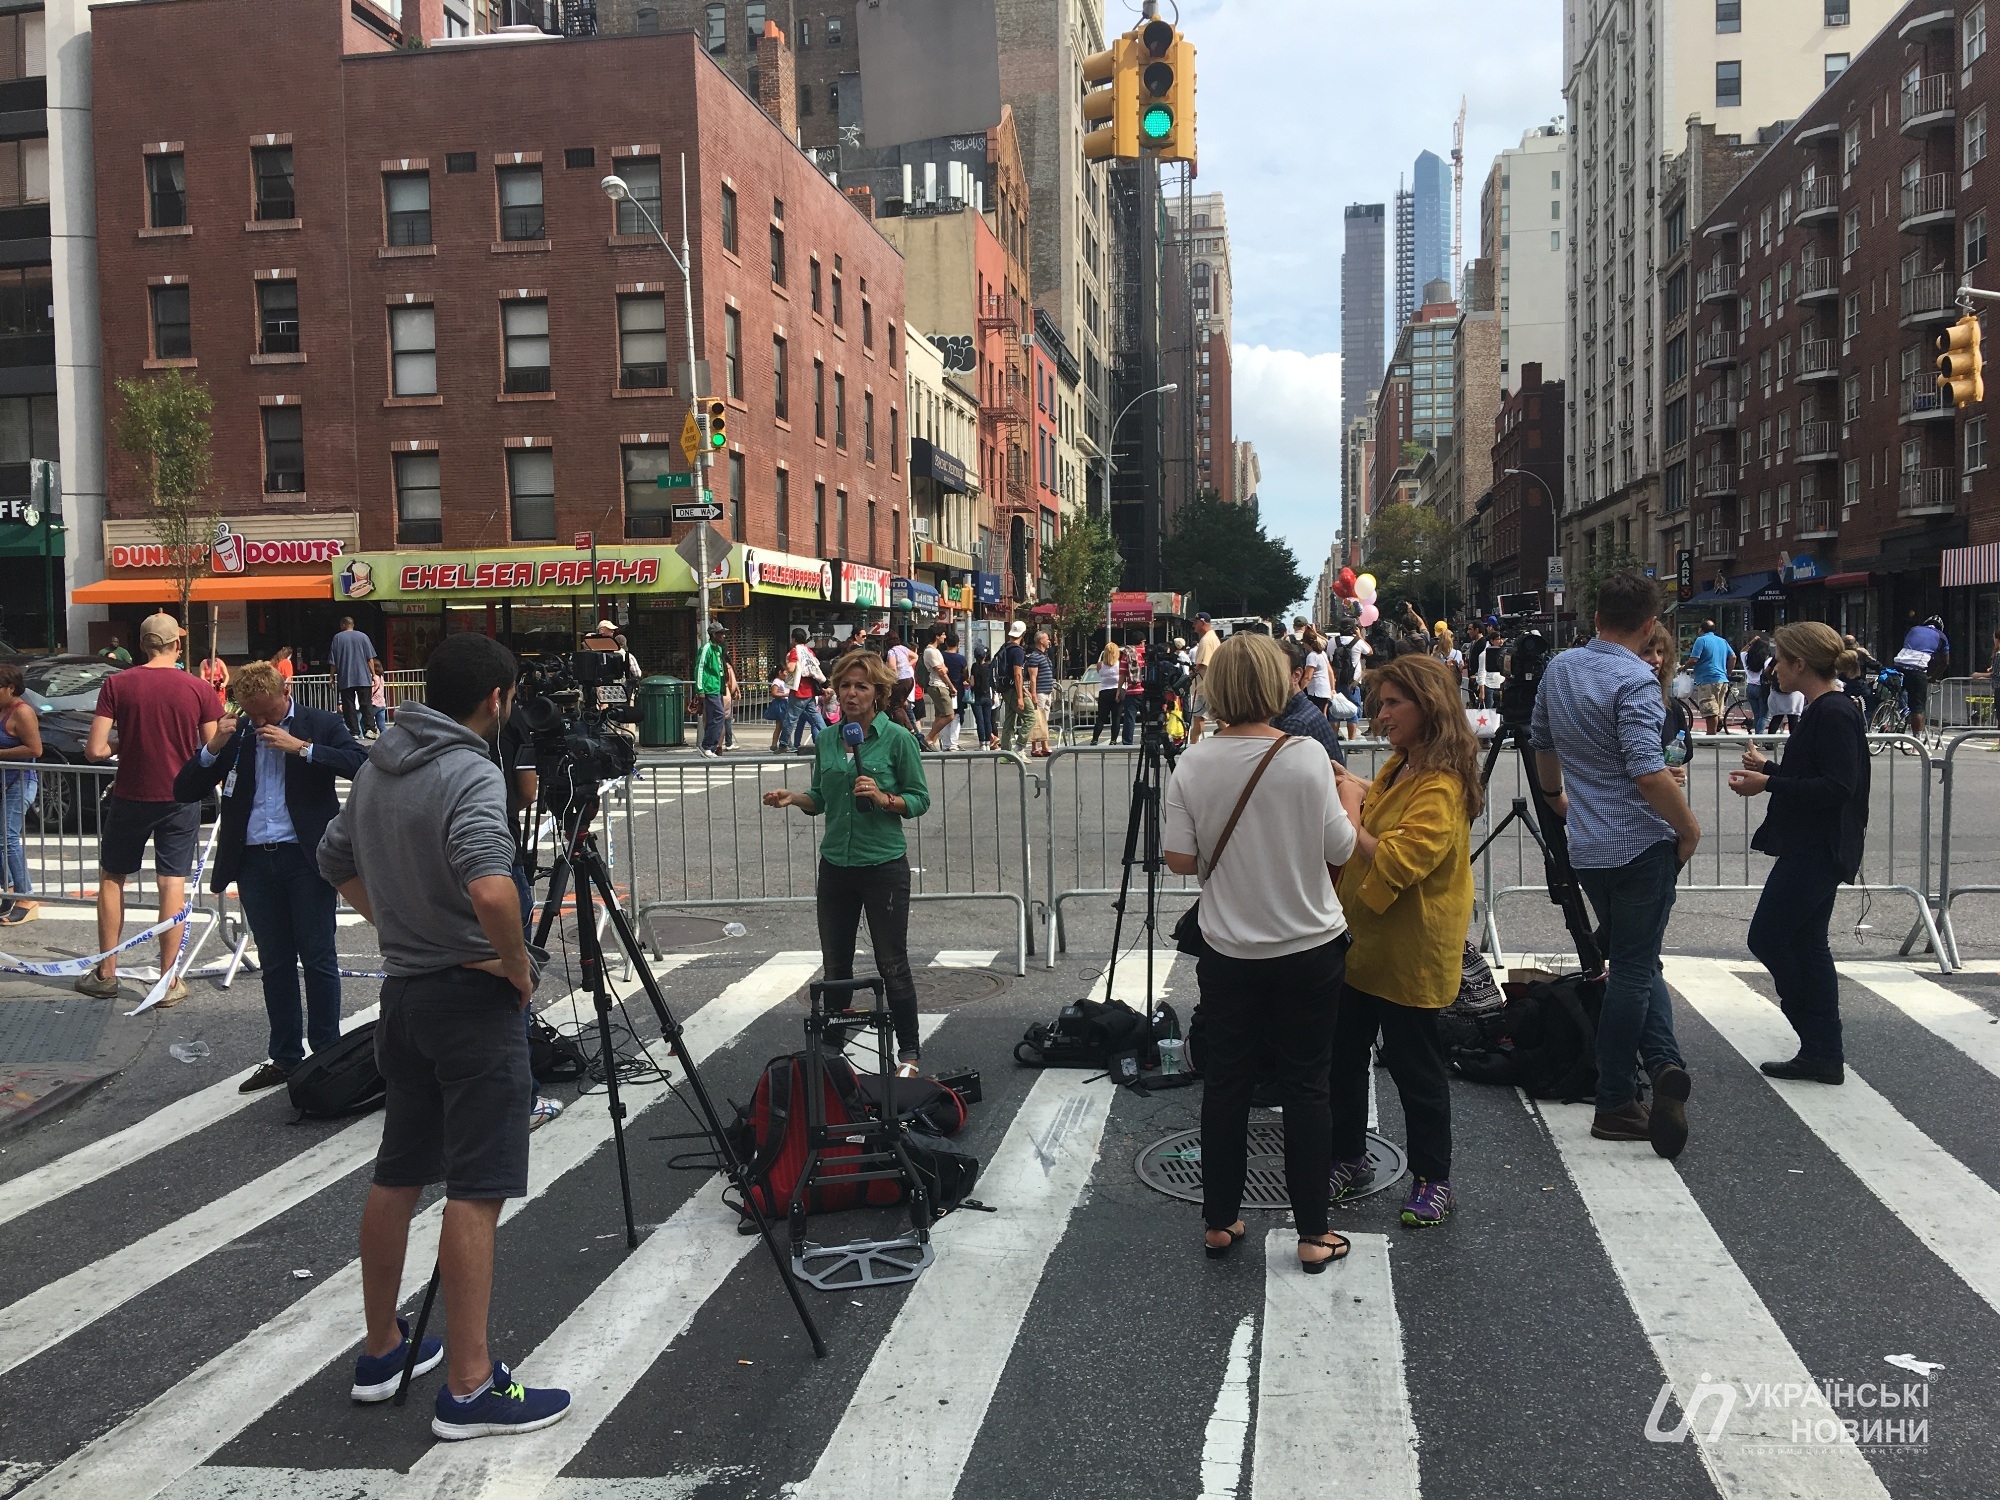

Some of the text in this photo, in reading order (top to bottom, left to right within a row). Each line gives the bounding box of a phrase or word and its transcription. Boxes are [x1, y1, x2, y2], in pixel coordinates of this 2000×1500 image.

[667, 476, 672, 487] 7
[680, 508, 716, 517] ONE WAY
[246, 540, 342, 564] DONUTS
[400, 558, 661, 590] CHELSEA PAPAYA
[761, 562, 821, 590] CHELSEA PAPAYA
[1550, 565, 1562, 573] 25
[1681, 552, 1690, 586] PARK
[856, 580, 877, 606] PIZZA
[405, 604, 425, 613] ATM
[846, 727, 860, 736] tve
